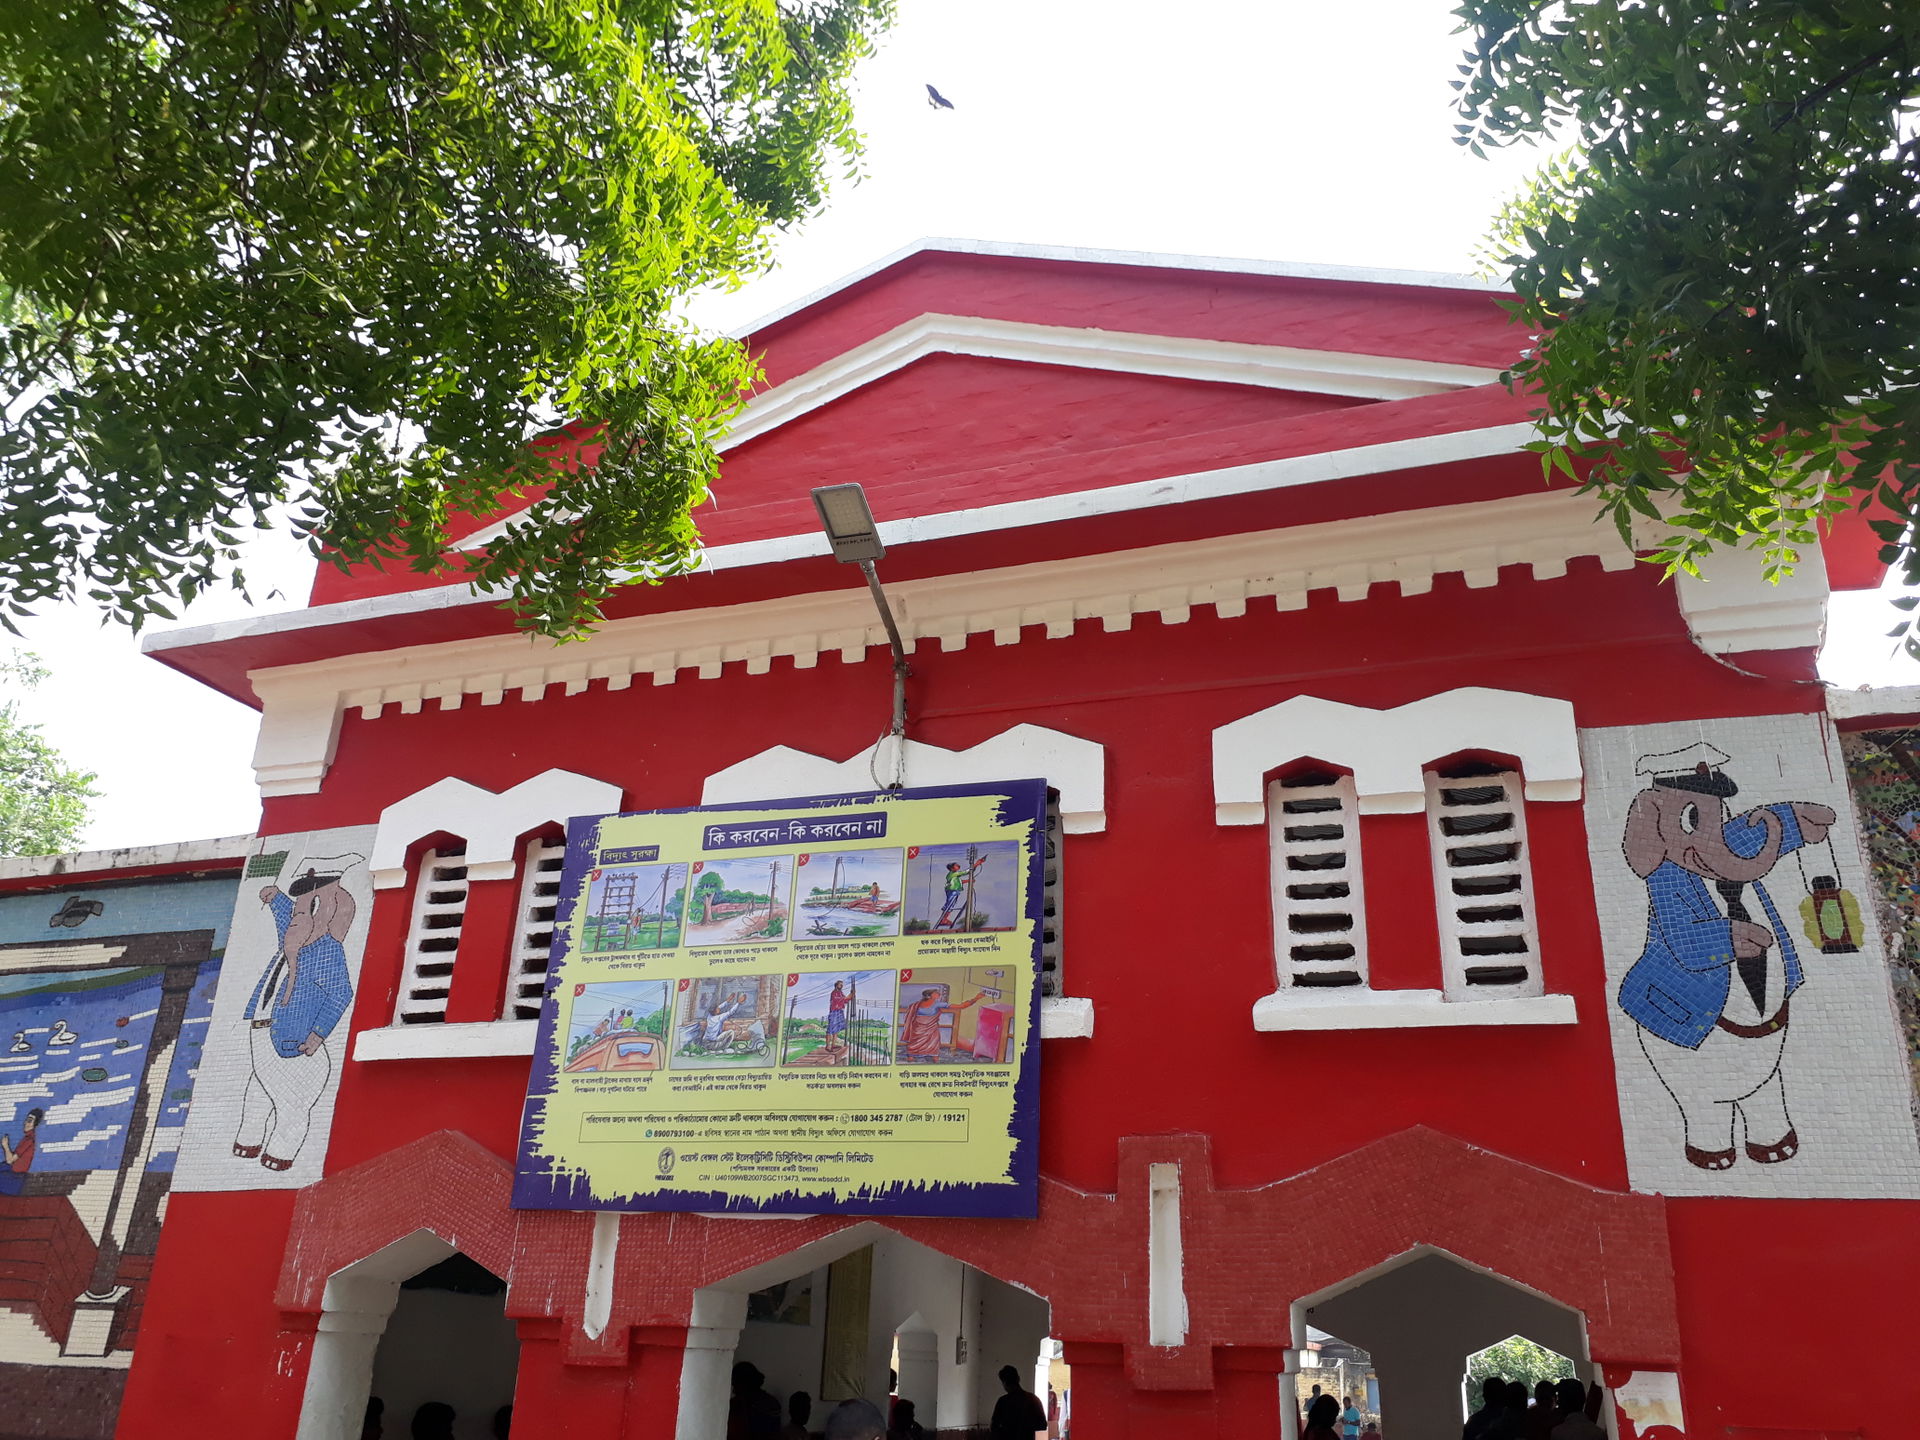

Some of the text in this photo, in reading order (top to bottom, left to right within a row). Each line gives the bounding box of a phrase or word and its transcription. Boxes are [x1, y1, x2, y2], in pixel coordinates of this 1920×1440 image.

[708, 827, 726, 846] কি
[810, 822, 862, 838] করবেন
[865, 819, 883, 834] না
[603, 849, 657, 862] বিদ্যুৎ সুরক্ষা
[789, 1114, 817, 1122] যোগাযোগ
[851, 1114, 868, 1122] 1800
[869, 1114, 883, 1122] 345
[885, 1114, 903, 1122] 2787
[943, 1114, 965, 1122] 19121
[848, 1129, 876, 1137] যোগাযোগ
[815, 1151, 844, 1163] কোম্পানি
[846, 1151, 874, 1163] লিমিটেড
